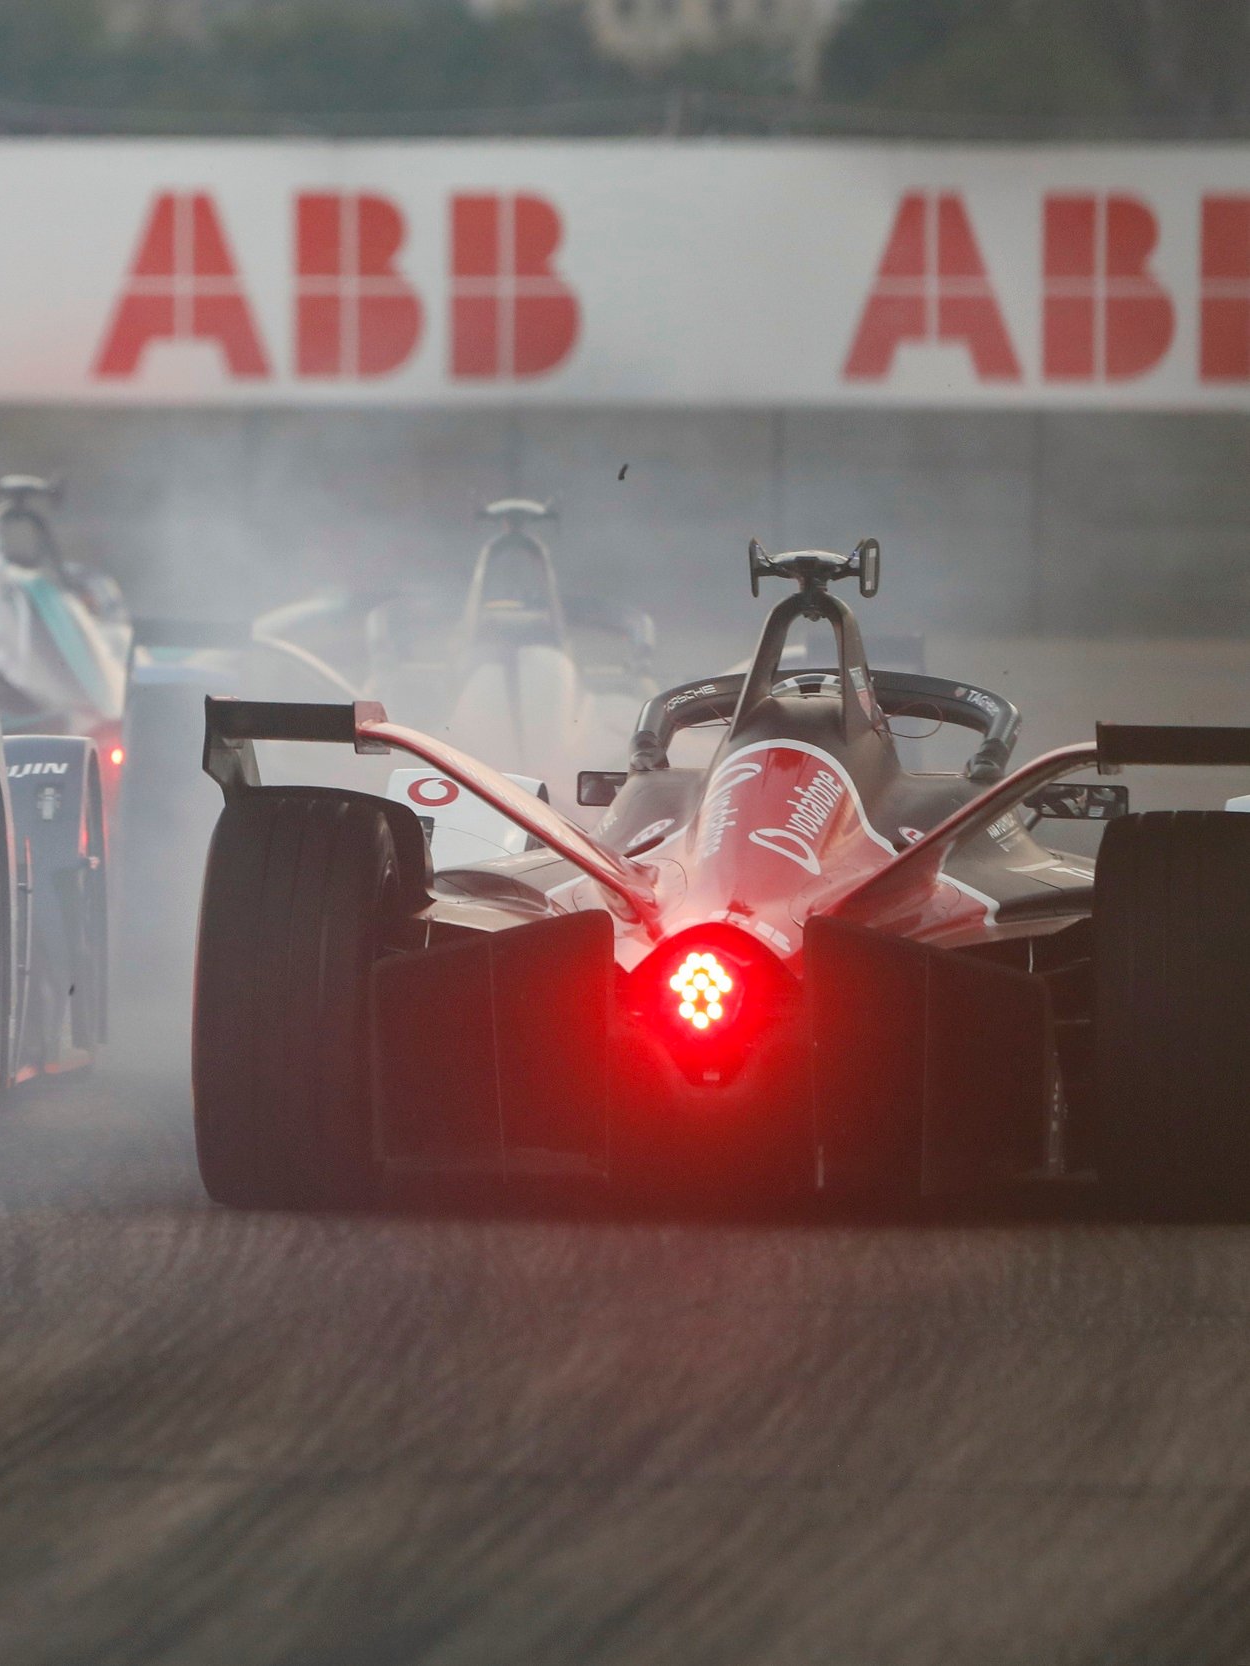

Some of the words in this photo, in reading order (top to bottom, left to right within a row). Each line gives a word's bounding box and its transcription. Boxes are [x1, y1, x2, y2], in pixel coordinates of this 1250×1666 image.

[90, 189, 581, 381] ABB
[6, 763, 69, 778] IJIN
[784, 770, 843, 841] vodafone
